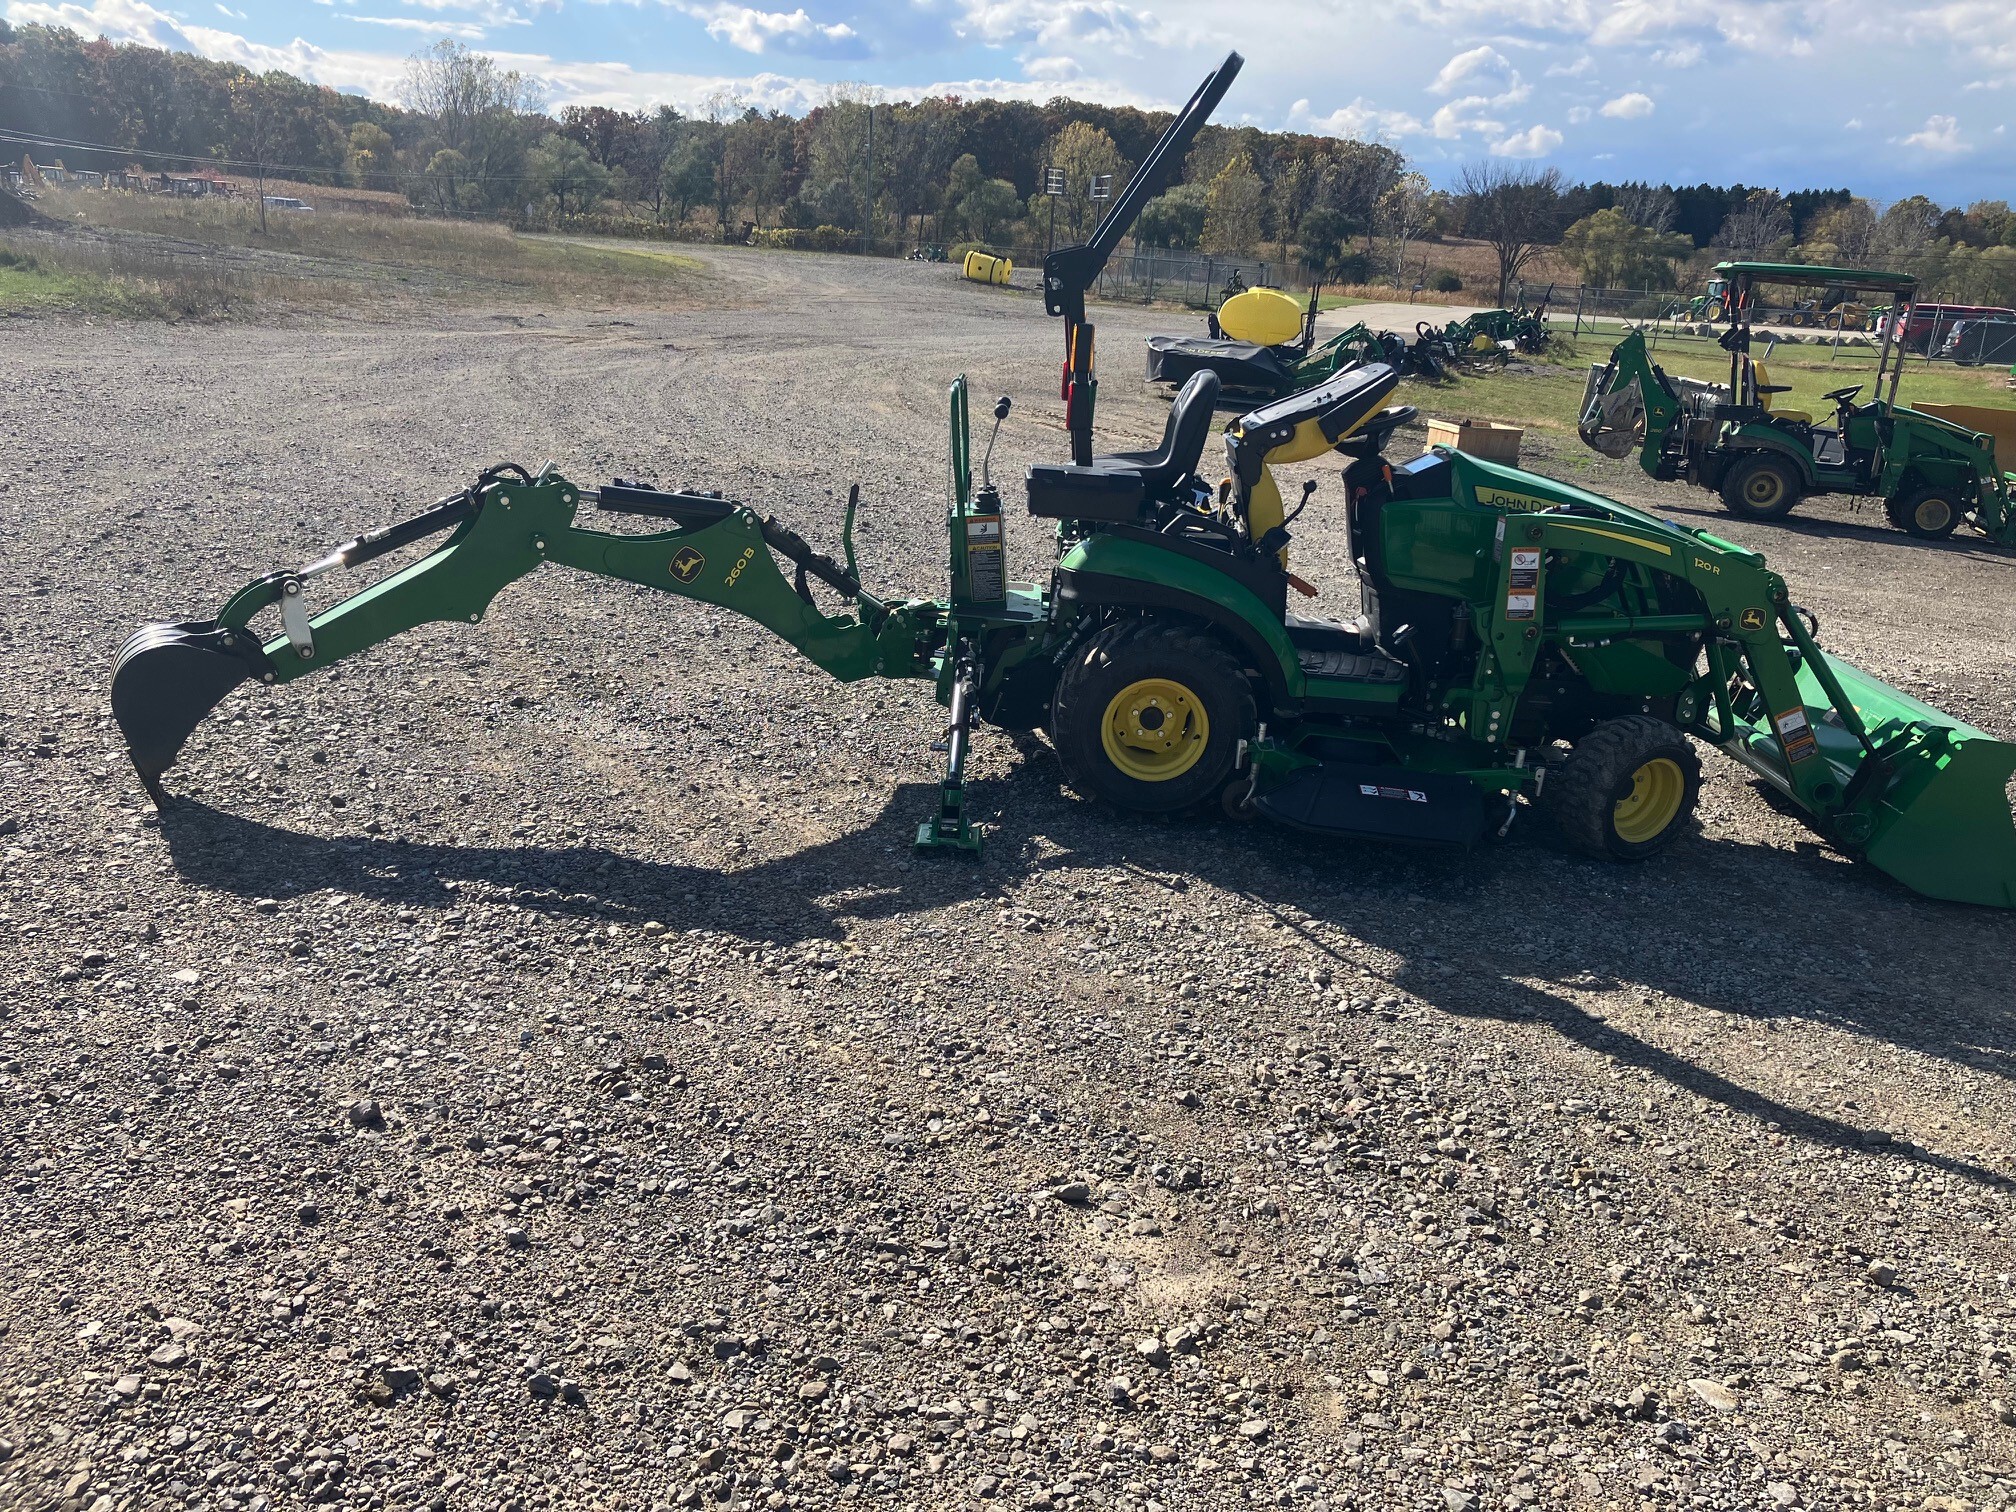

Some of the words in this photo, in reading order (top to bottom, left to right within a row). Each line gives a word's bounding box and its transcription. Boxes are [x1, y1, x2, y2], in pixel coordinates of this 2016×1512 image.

[1486, 493, 1527, 510] JOHN
[724, 558, 747, 587] 260
[743, 547, 755, 559] B
[1694, 557, 1712, 571] 120
[1712, 565, 1720, 575] R
